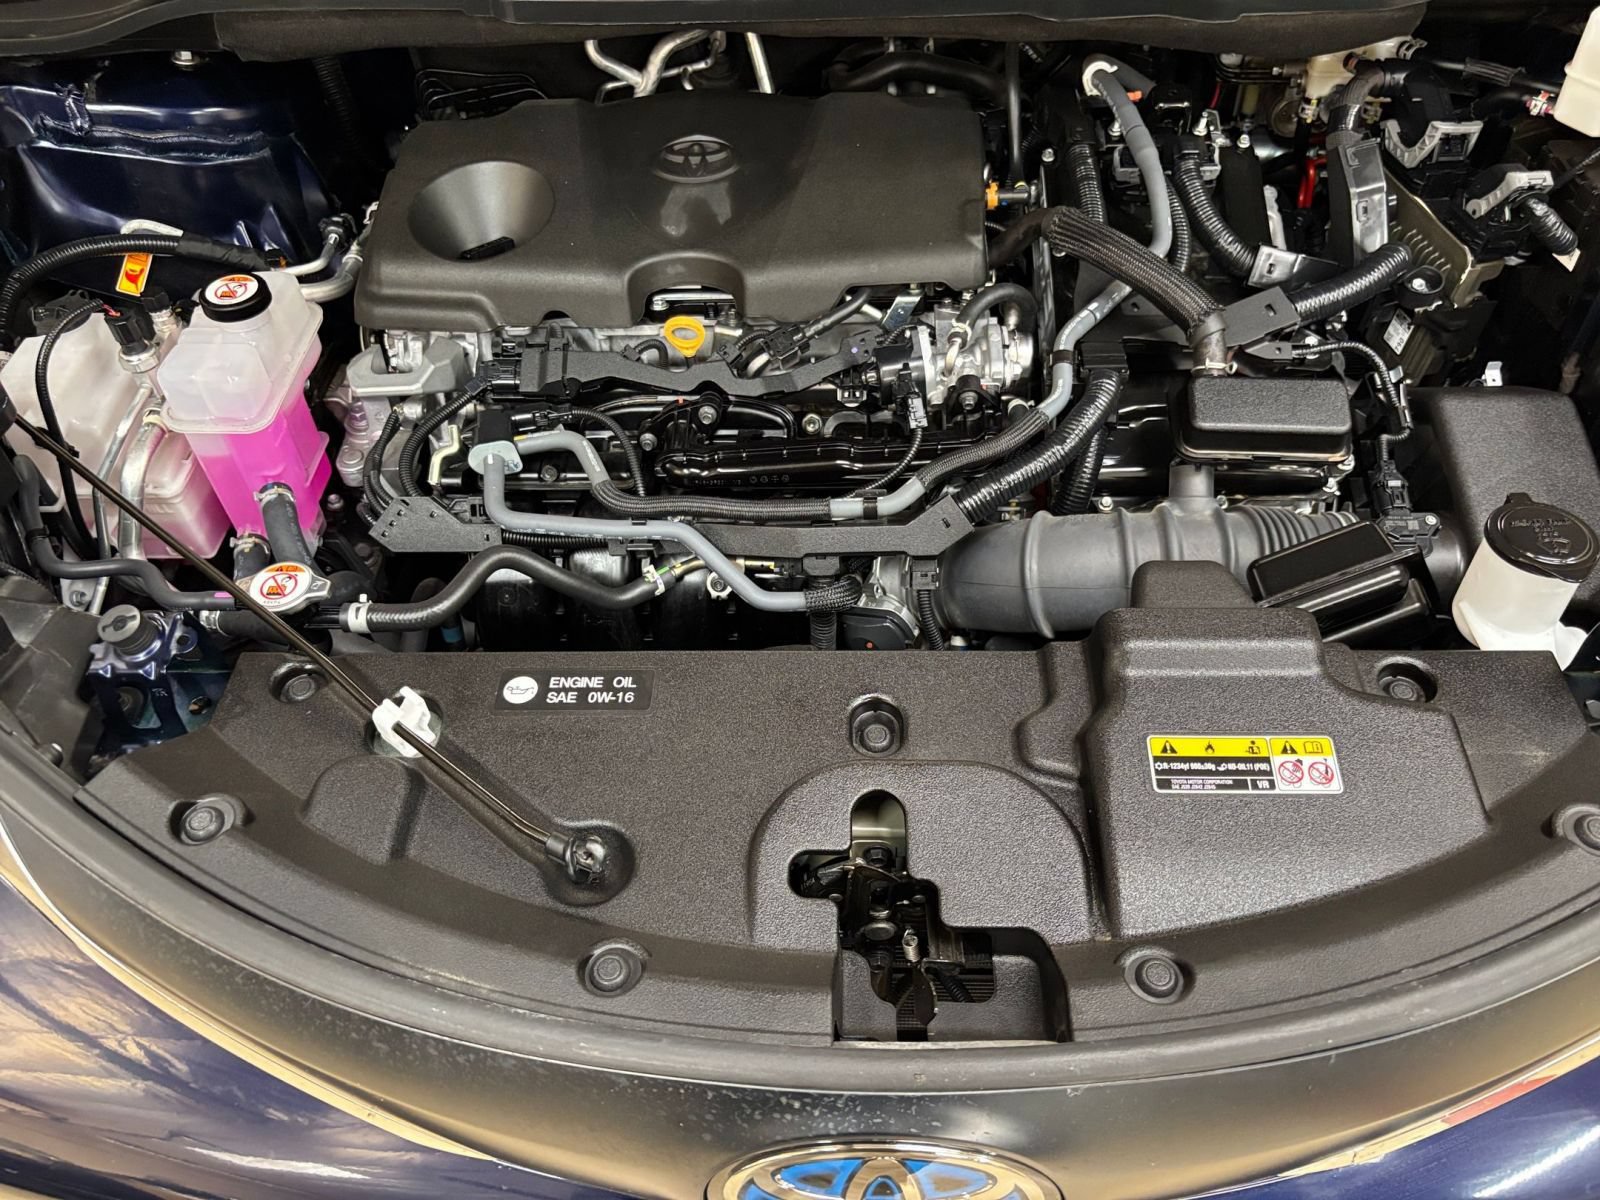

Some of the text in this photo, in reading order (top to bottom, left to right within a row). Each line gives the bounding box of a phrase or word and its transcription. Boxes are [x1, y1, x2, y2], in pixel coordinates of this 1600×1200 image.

[549, 676, 637, 688] ENGINE OIL
[546, 691, 635, 703] SAE 0W-16
[1256, 780, 1270, 789] VR
